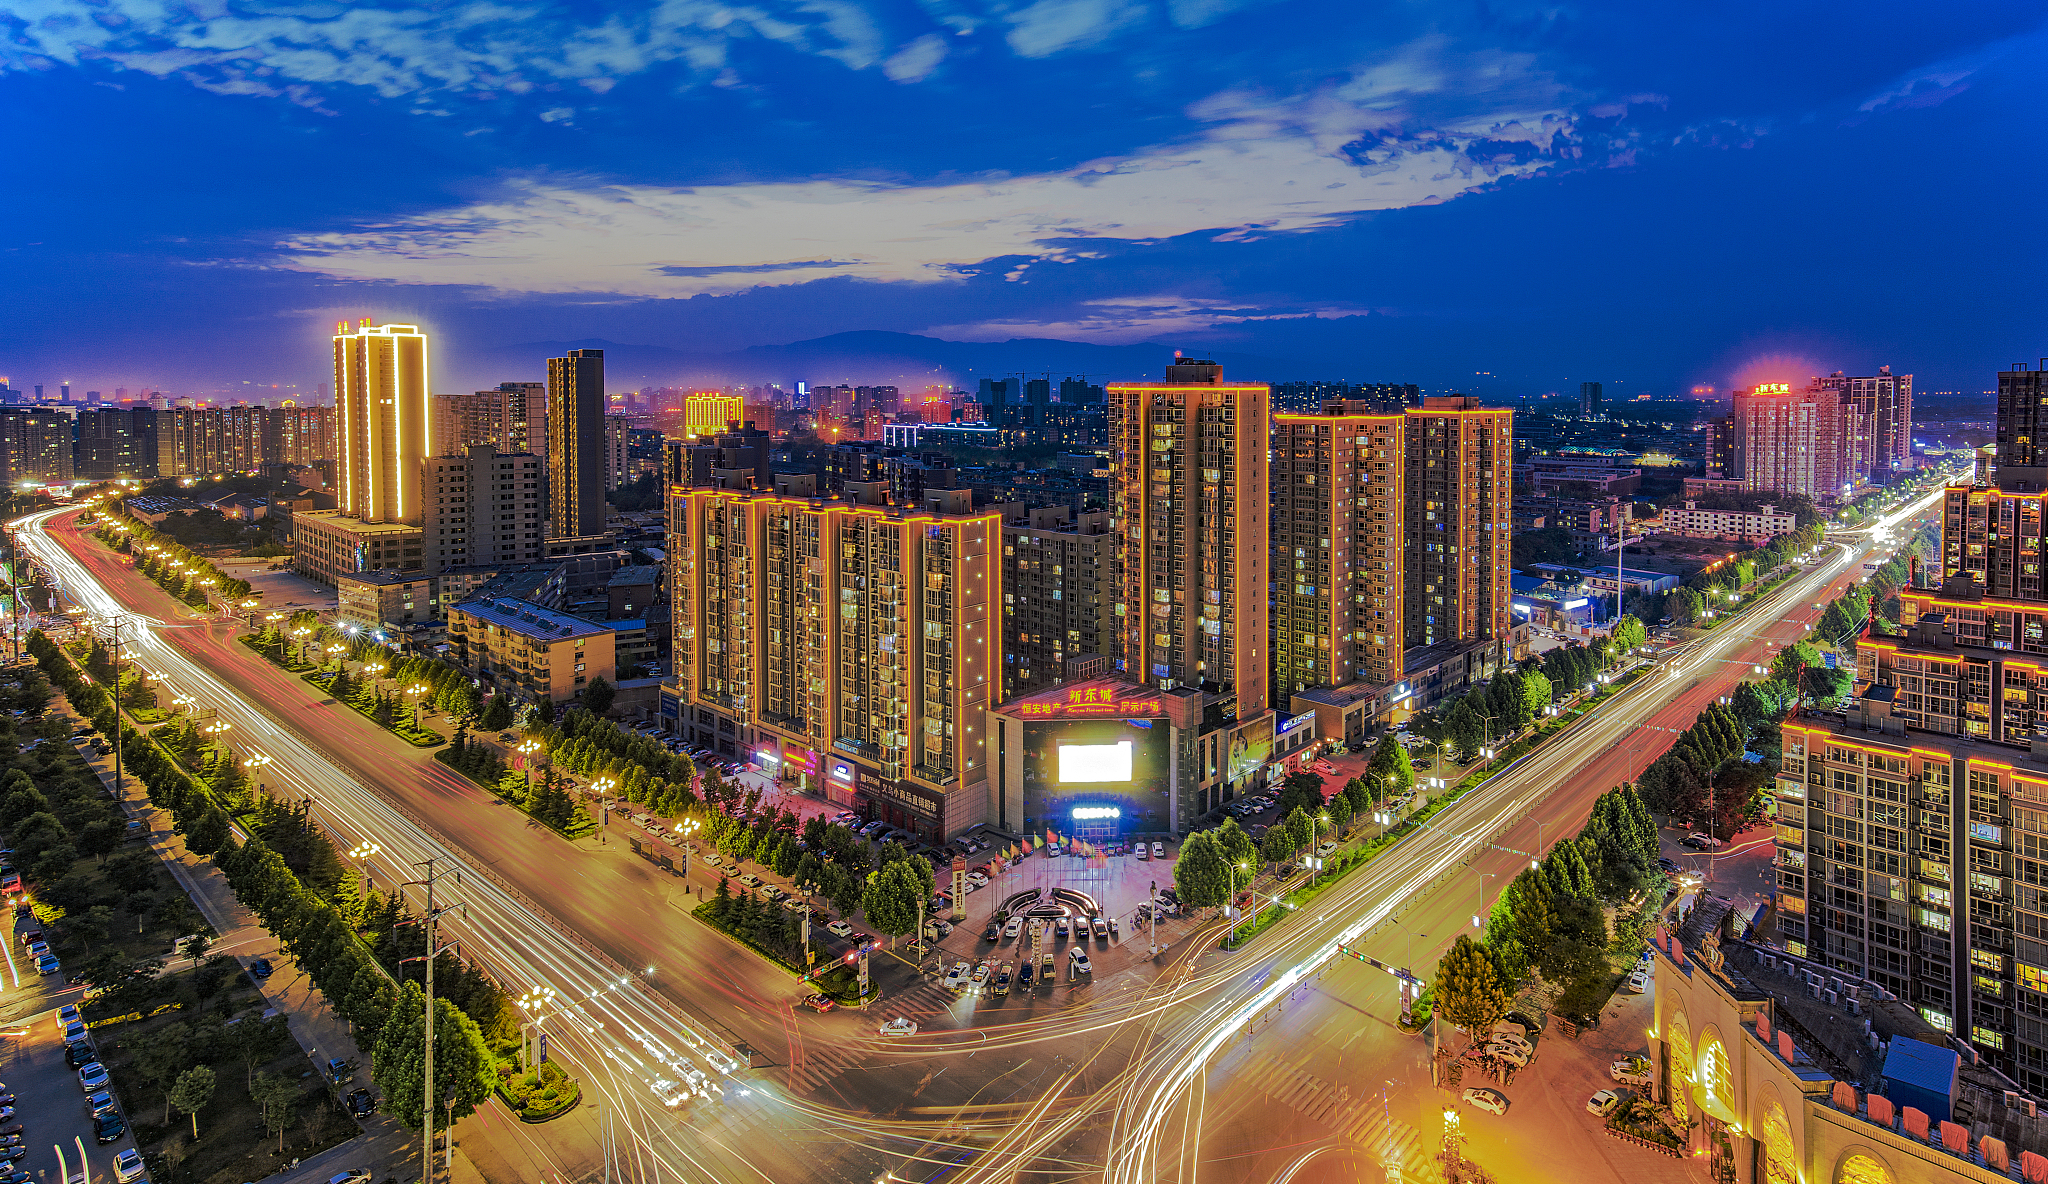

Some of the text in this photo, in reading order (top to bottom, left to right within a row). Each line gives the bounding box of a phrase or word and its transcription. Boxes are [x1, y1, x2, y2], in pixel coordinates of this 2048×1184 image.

[1069, 688, 1112, 703] 新东城
[1022, 702, 1061, 714] 恒安地产
